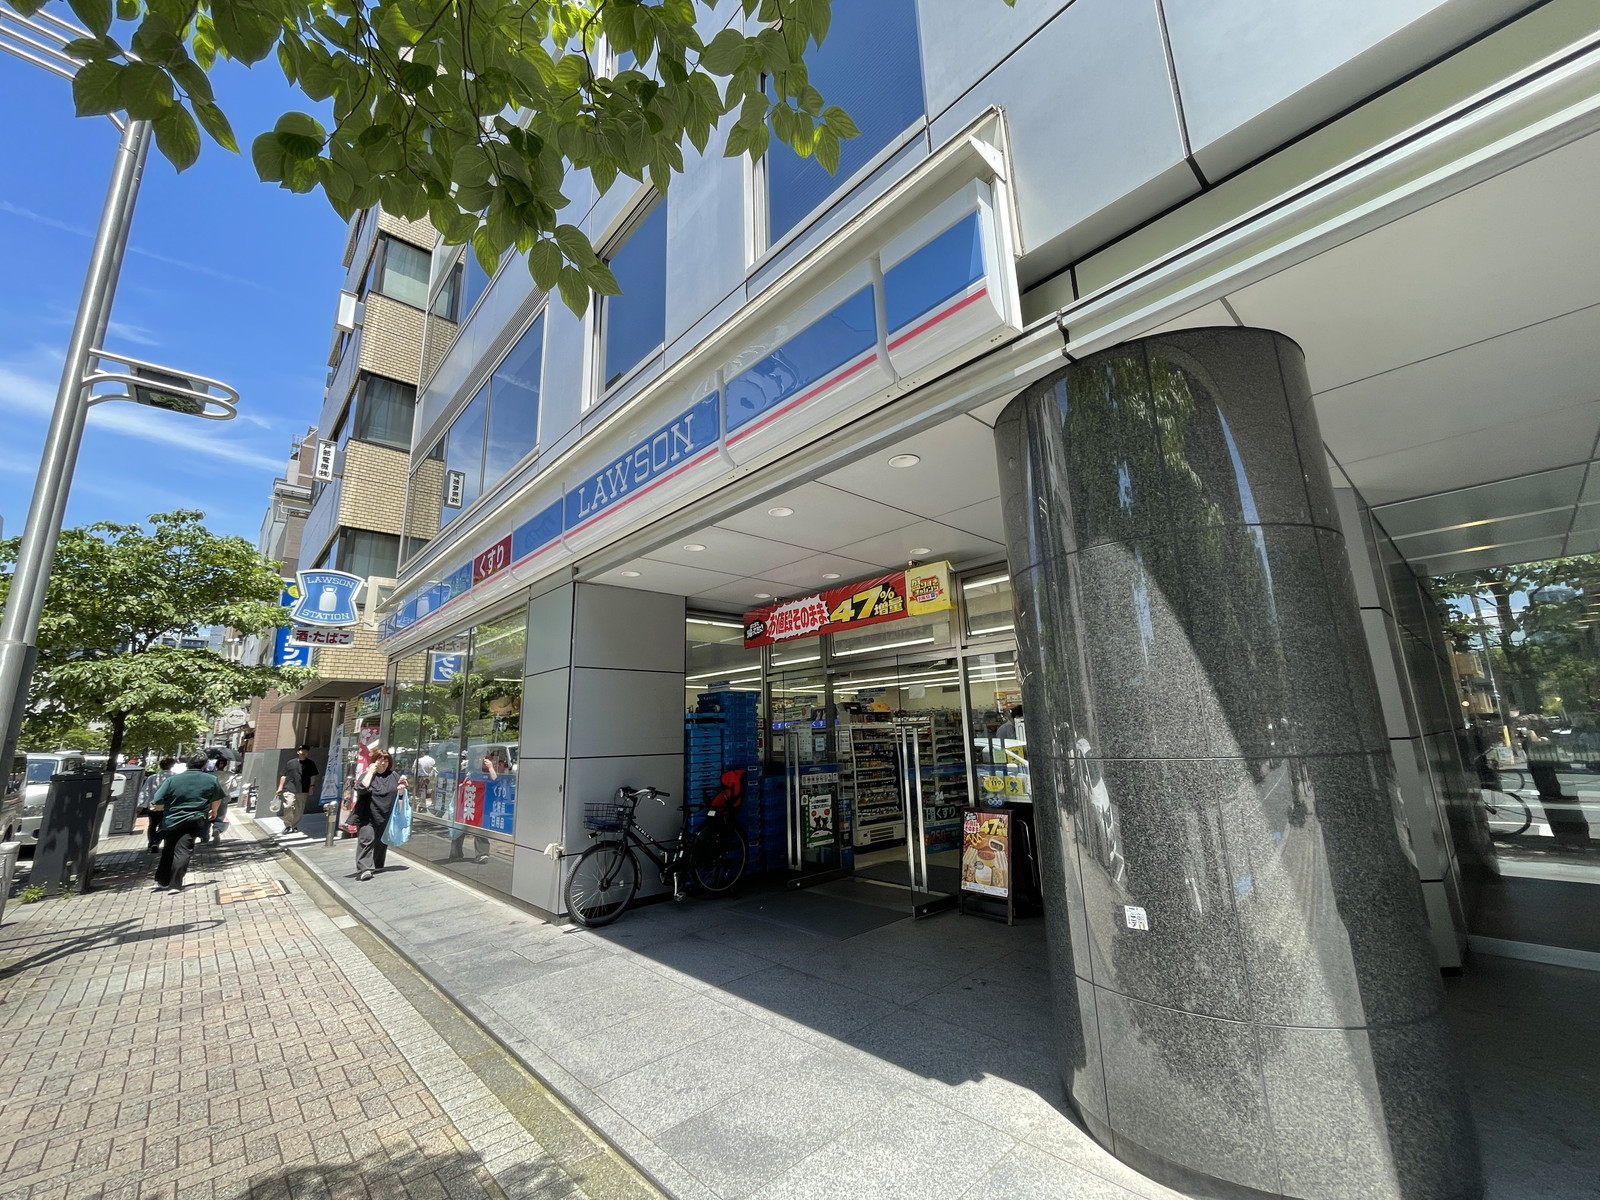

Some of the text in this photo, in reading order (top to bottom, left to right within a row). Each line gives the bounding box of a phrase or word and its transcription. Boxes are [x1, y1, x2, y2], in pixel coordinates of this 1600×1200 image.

[578, 413, 694, 518] LAWSON
[479, 545, 504, 578] くすり
[306, 576, 355, 589] LAWSON
[302, 609, 350, 620] STATION
[767, 602, 829, 636] お値段そのまま
[296, 629, 349, 645] 酒・たばこ
[493, 785, 507, 798] くすり
[936, 806, 956, 819] くすり
